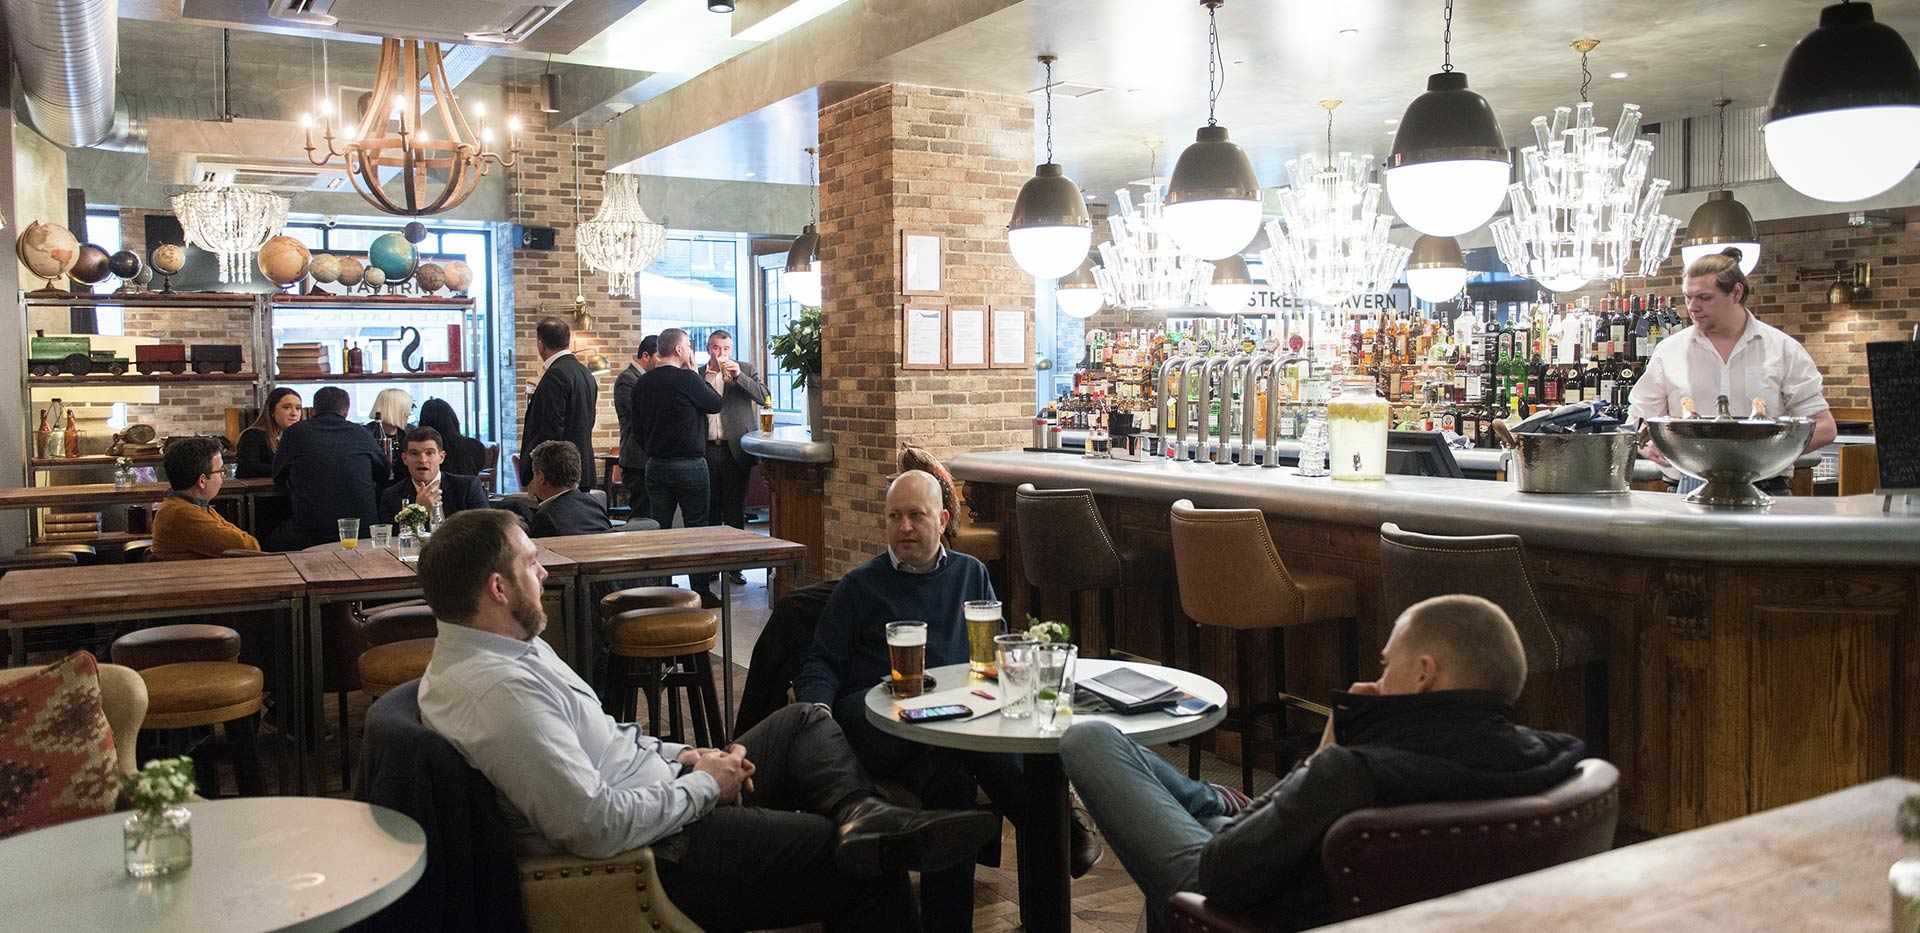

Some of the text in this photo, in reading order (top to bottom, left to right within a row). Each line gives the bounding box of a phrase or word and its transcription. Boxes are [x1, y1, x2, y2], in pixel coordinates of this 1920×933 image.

[347, 281, 428, 294] AERN
[1247, 290, 1397, 309] STREE AVERN
